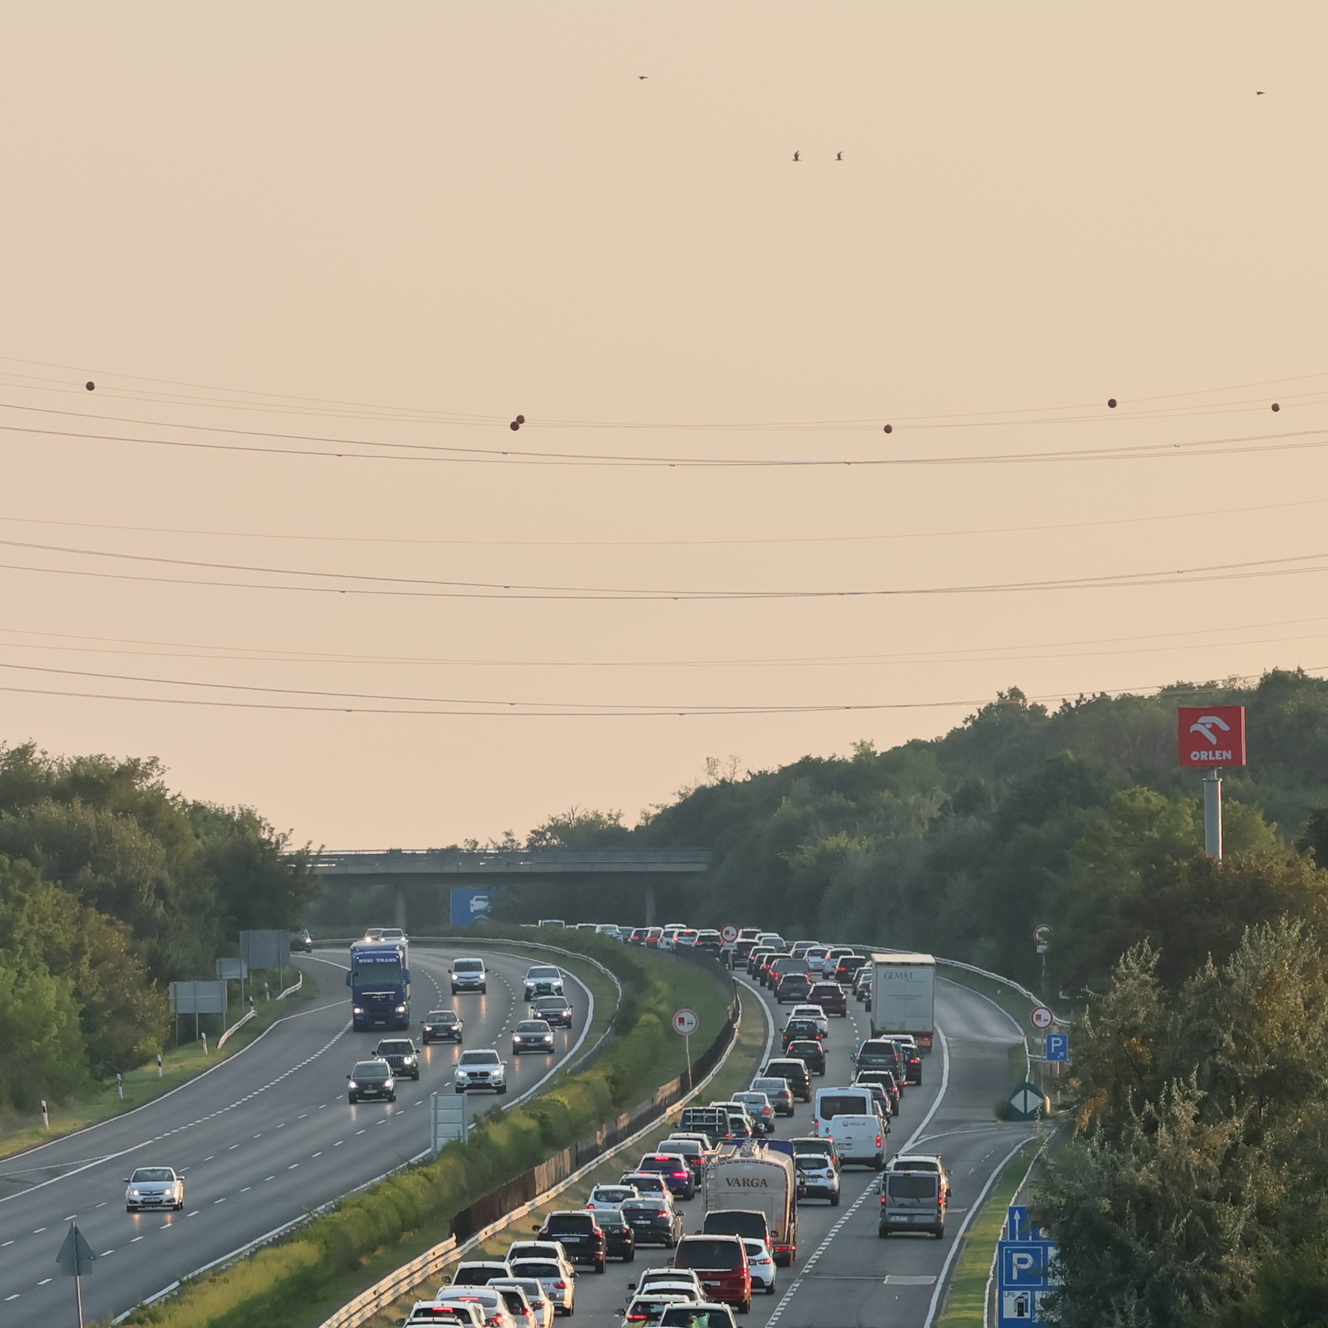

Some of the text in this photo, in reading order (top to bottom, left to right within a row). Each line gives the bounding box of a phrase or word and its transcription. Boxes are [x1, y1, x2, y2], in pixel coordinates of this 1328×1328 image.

[1190, 750, 1232, 761] ORLEN
[1051, 1037, 1063, 1053] P
[725, 1177, 769, 1189] VARGA
[1012, 1253, 1034, 1281] P
